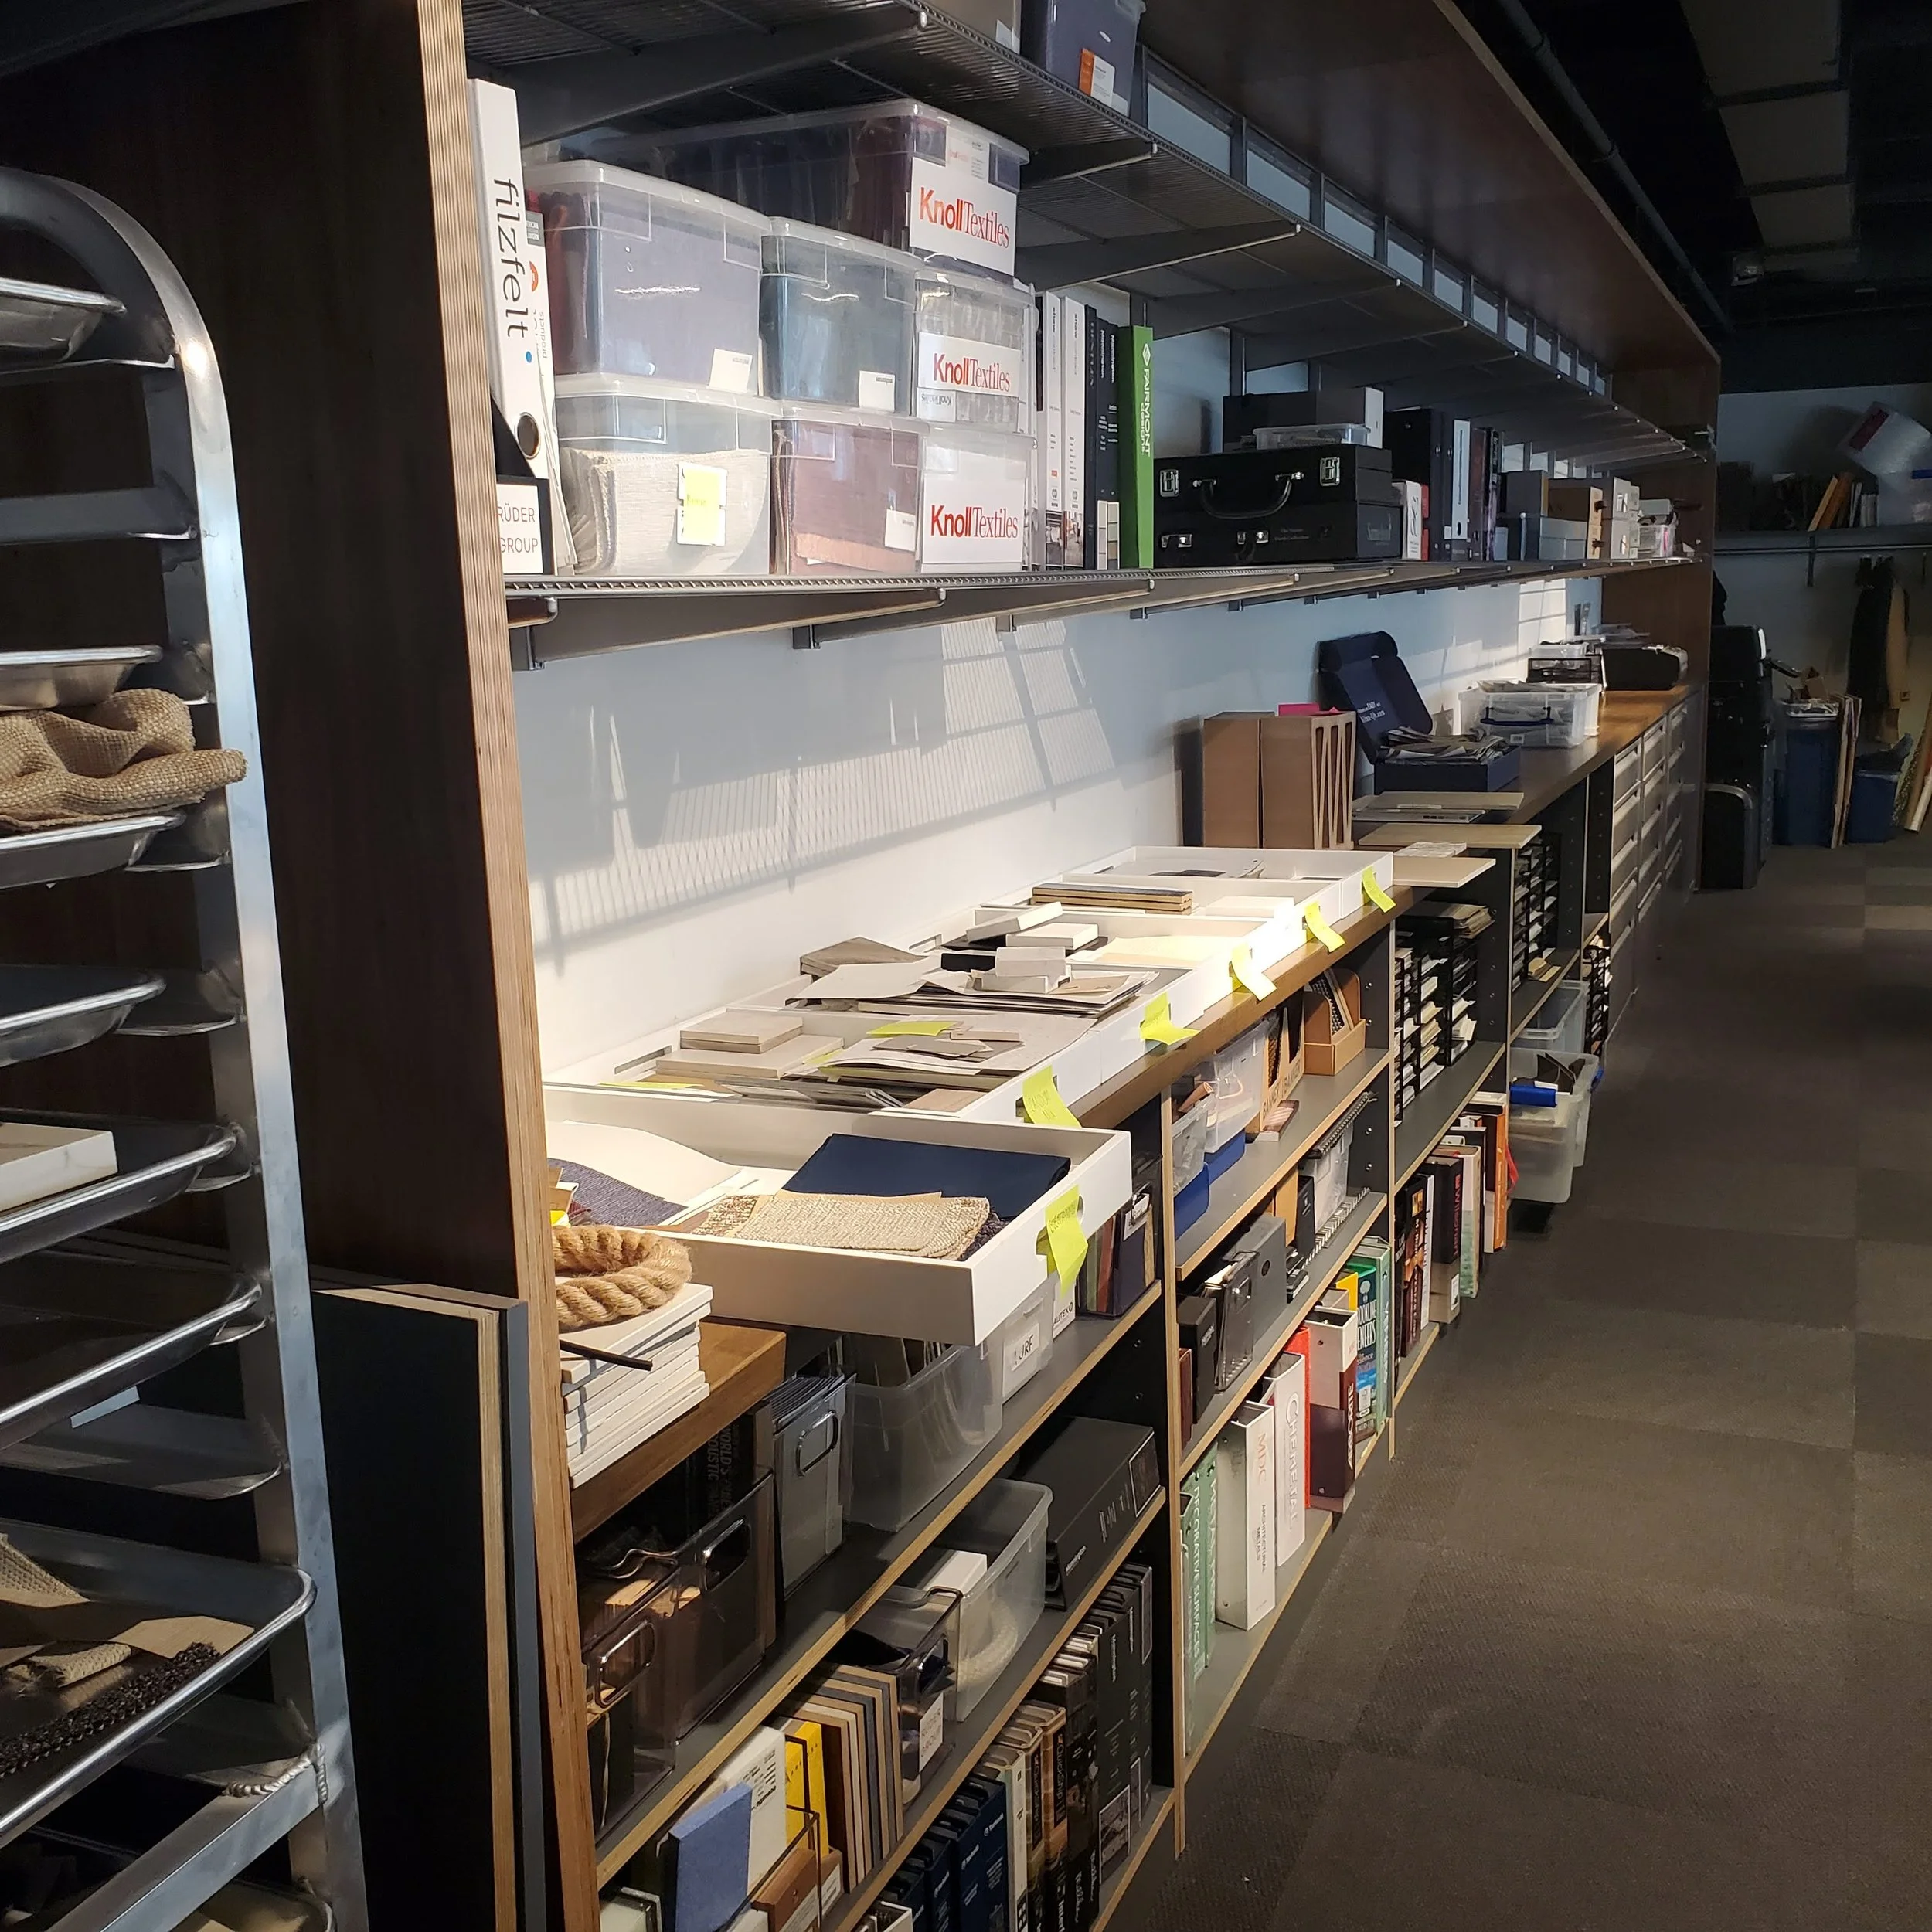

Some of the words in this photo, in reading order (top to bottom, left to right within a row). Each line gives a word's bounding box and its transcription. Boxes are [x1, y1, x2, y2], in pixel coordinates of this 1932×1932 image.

[920, 186, 1009, 248] KnollTextiles
[494, 179, 529, 338] filzfelt
[934, 352, 1010, 393] KnollTextiles
[930, 504, 1018, 538] KnollTextiles
[499, 537, 539, 553] GROUP
[1357, 1324, 1376, 1352] ENEERS
[1256, 1433, 1266, 1485] MDC
